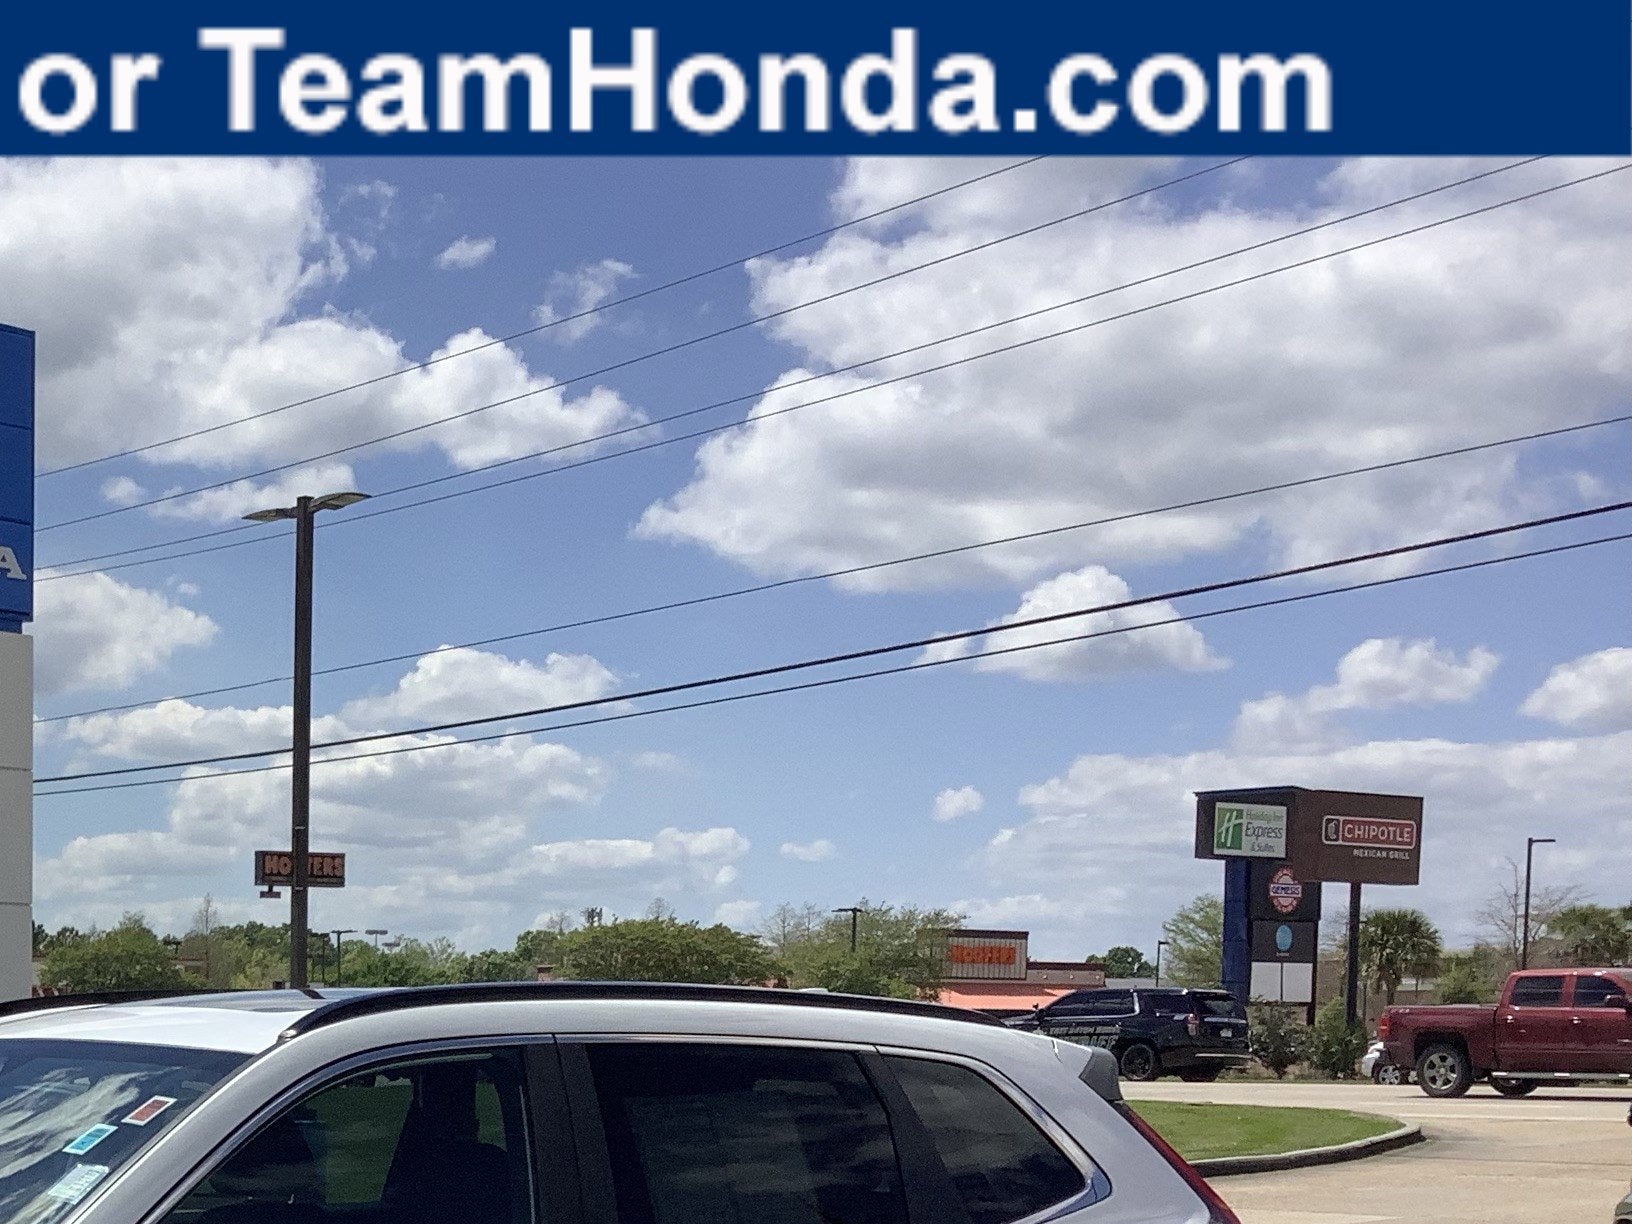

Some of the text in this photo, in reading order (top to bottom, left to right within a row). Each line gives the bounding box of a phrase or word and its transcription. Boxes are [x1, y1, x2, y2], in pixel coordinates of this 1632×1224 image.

[1245, 822, 1283, 840] Express
[1344, 824, 1412, 842] CHIPOTLE
[1353, 849, 1410, 860] MEXICAN GRILL
